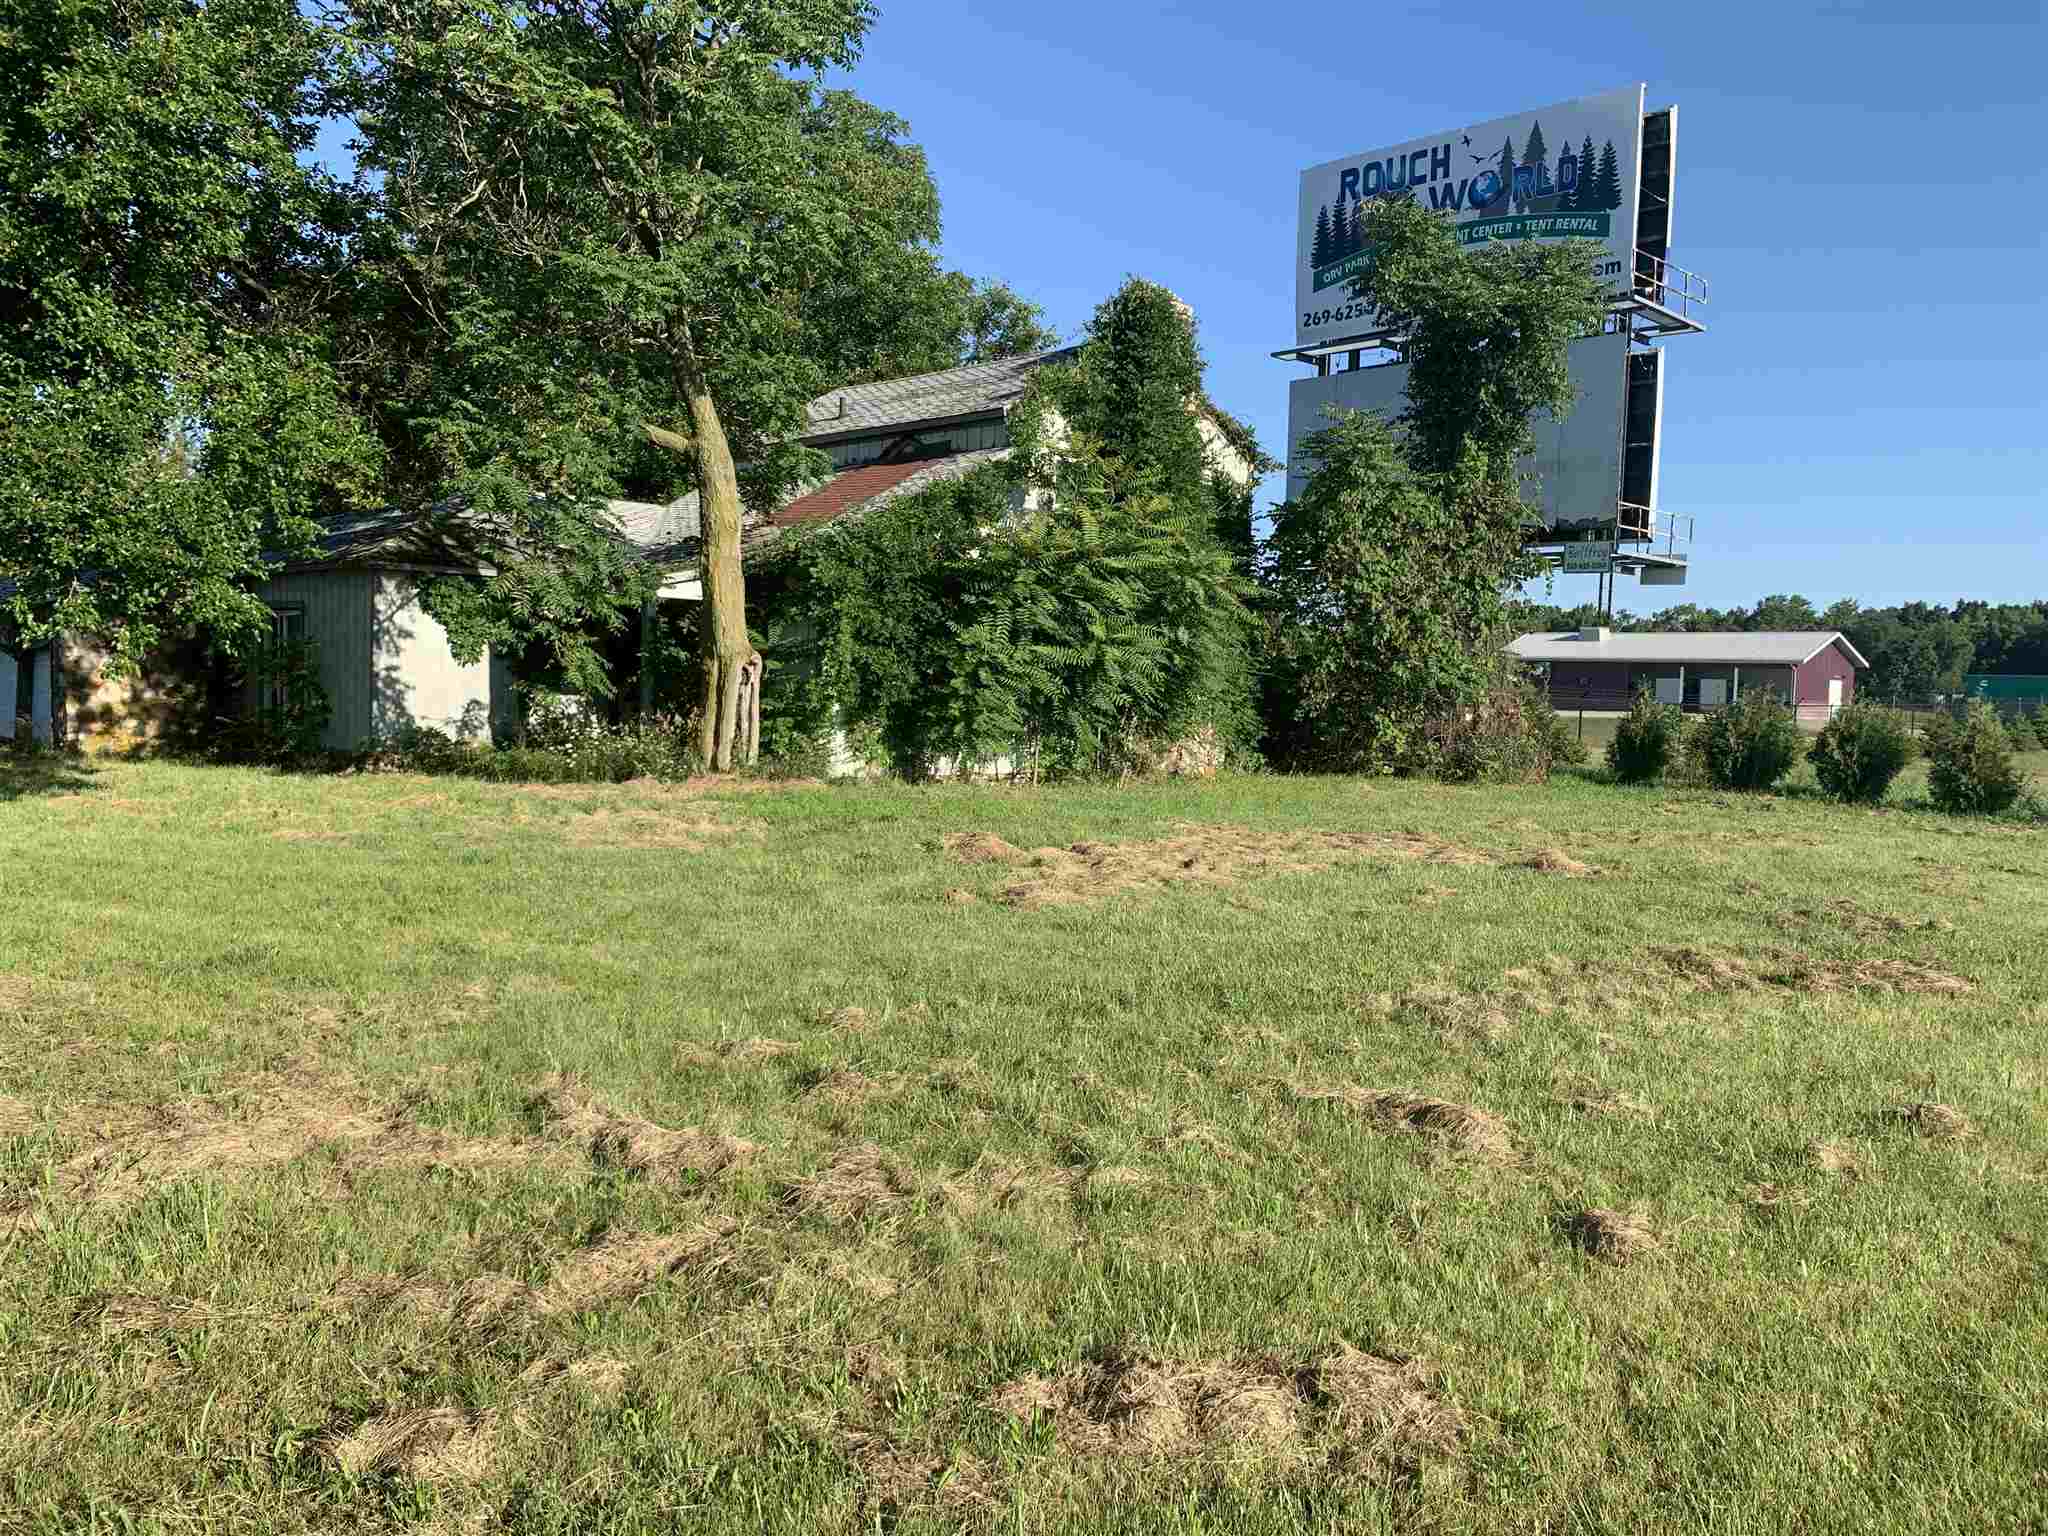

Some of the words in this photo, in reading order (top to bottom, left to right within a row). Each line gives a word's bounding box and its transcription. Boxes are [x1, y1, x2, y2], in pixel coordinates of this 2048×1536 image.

[1427, 153, 1578, 209] WORLD
[1323, 265, 1344, 283] ORV
[1345, 254, 1370, 273] PARK
[1472, 221, 1513, 240] CENTER
[1525, 217, 1553, 232] TENT
[1554, 216, 1599, 232] RENTAL
